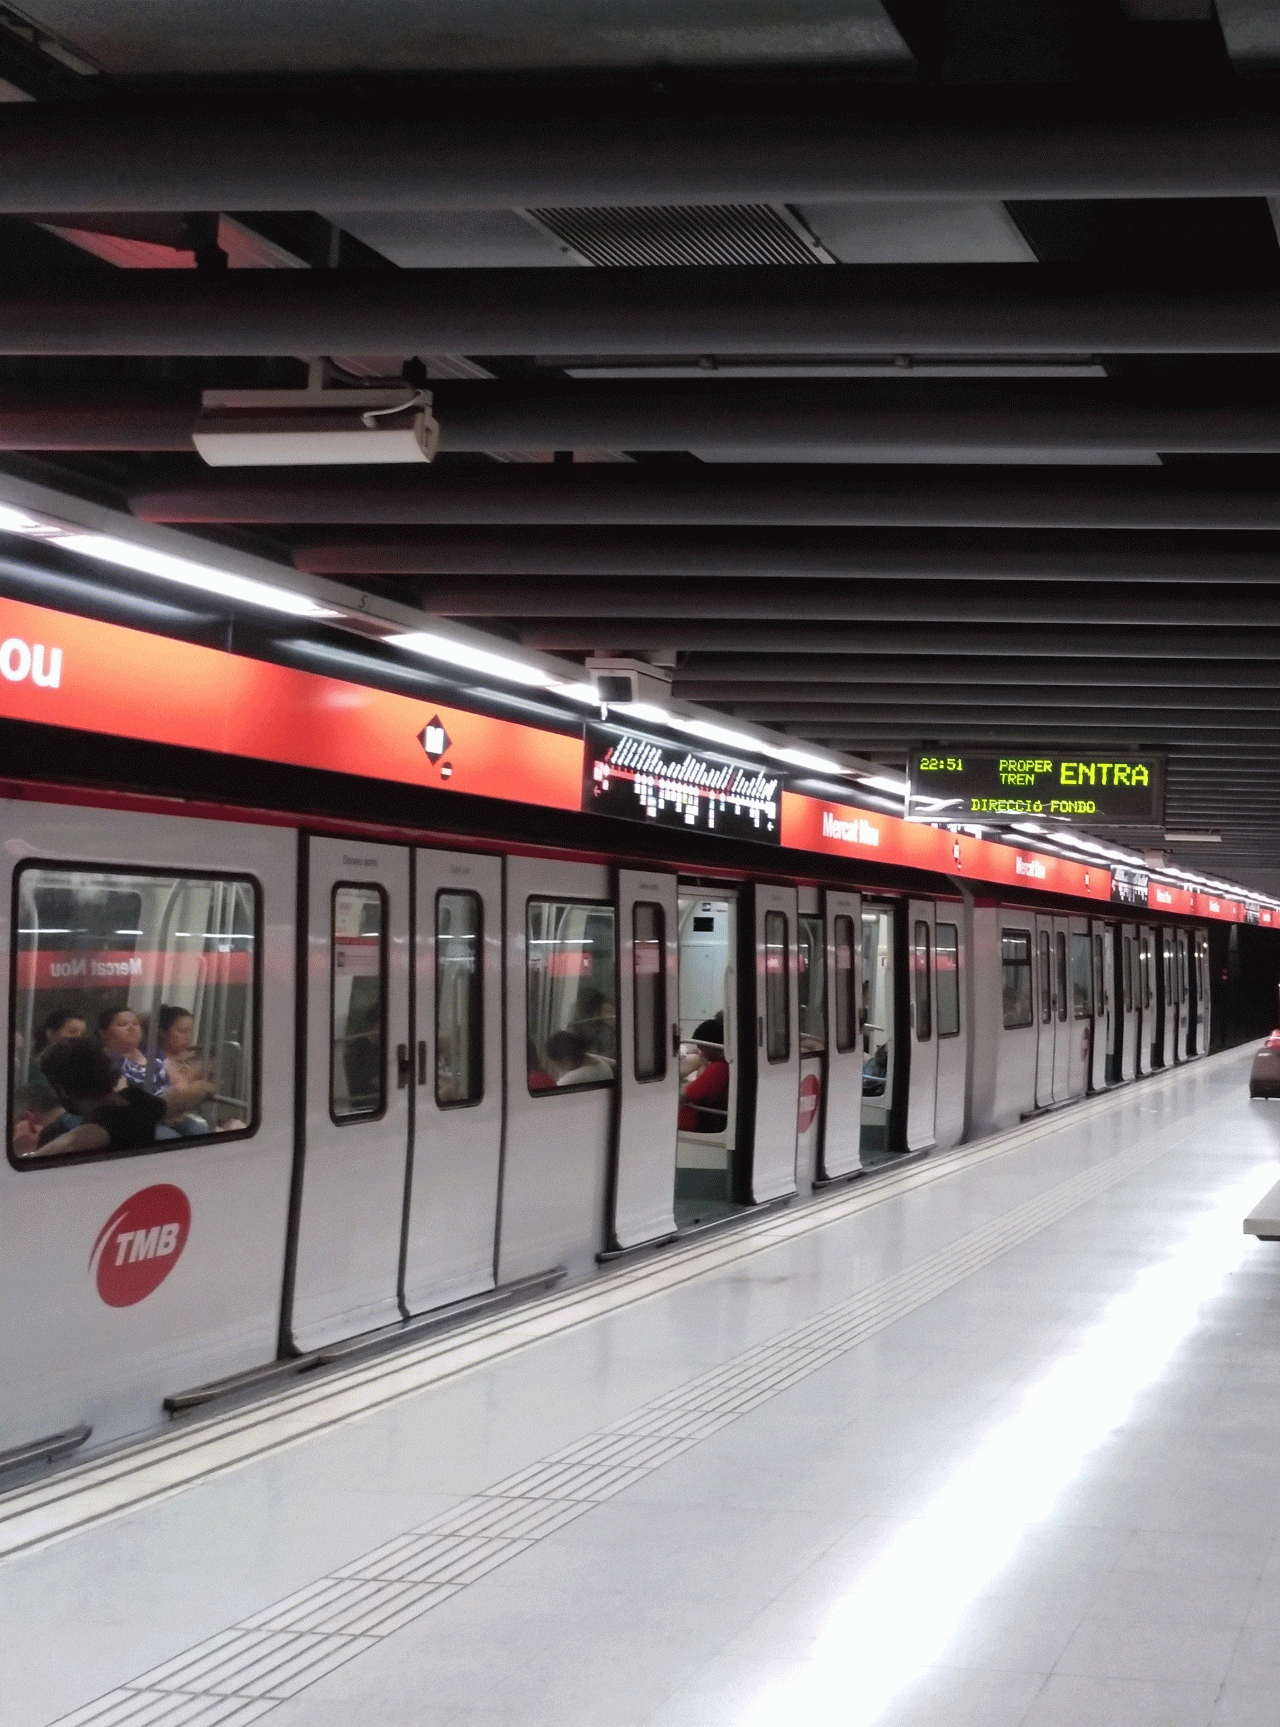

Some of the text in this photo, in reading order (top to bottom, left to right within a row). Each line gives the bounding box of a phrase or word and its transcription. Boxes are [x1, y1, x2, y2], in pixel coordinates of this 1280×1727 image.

[920, 758, 963, 771] 22:51
[999, 760, 1149, 786] PROPER ENTRA
[1000, 772, 1035, 786] TREN
[1050, 800, 1096, 814] FONDO
[114, 1222, 180, 1267] TMB
